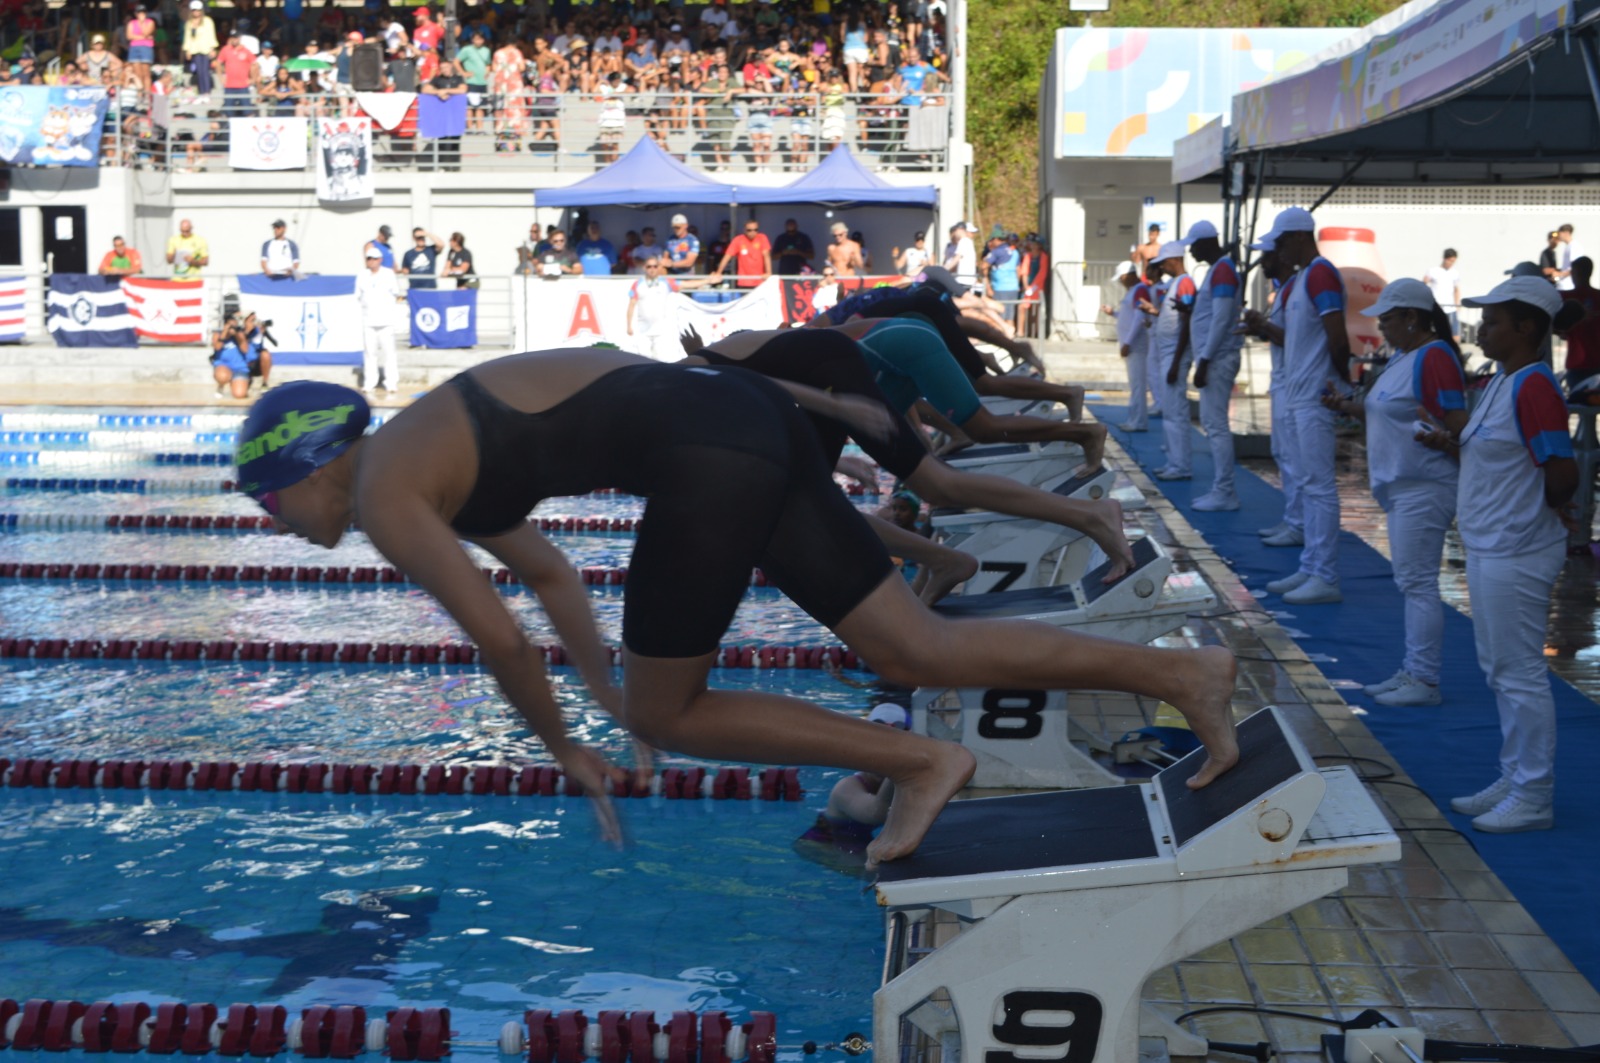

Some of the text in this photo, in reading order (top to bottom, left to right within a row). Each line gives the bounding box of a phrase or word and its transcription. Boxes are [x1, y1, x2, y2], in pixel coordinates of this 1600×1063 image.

[566, 292, 603, 339] A
[981, 561, 1028, 593] 7
[977, 689, 1047, 739] 8
[986, 991, 1103, 1063] 9
